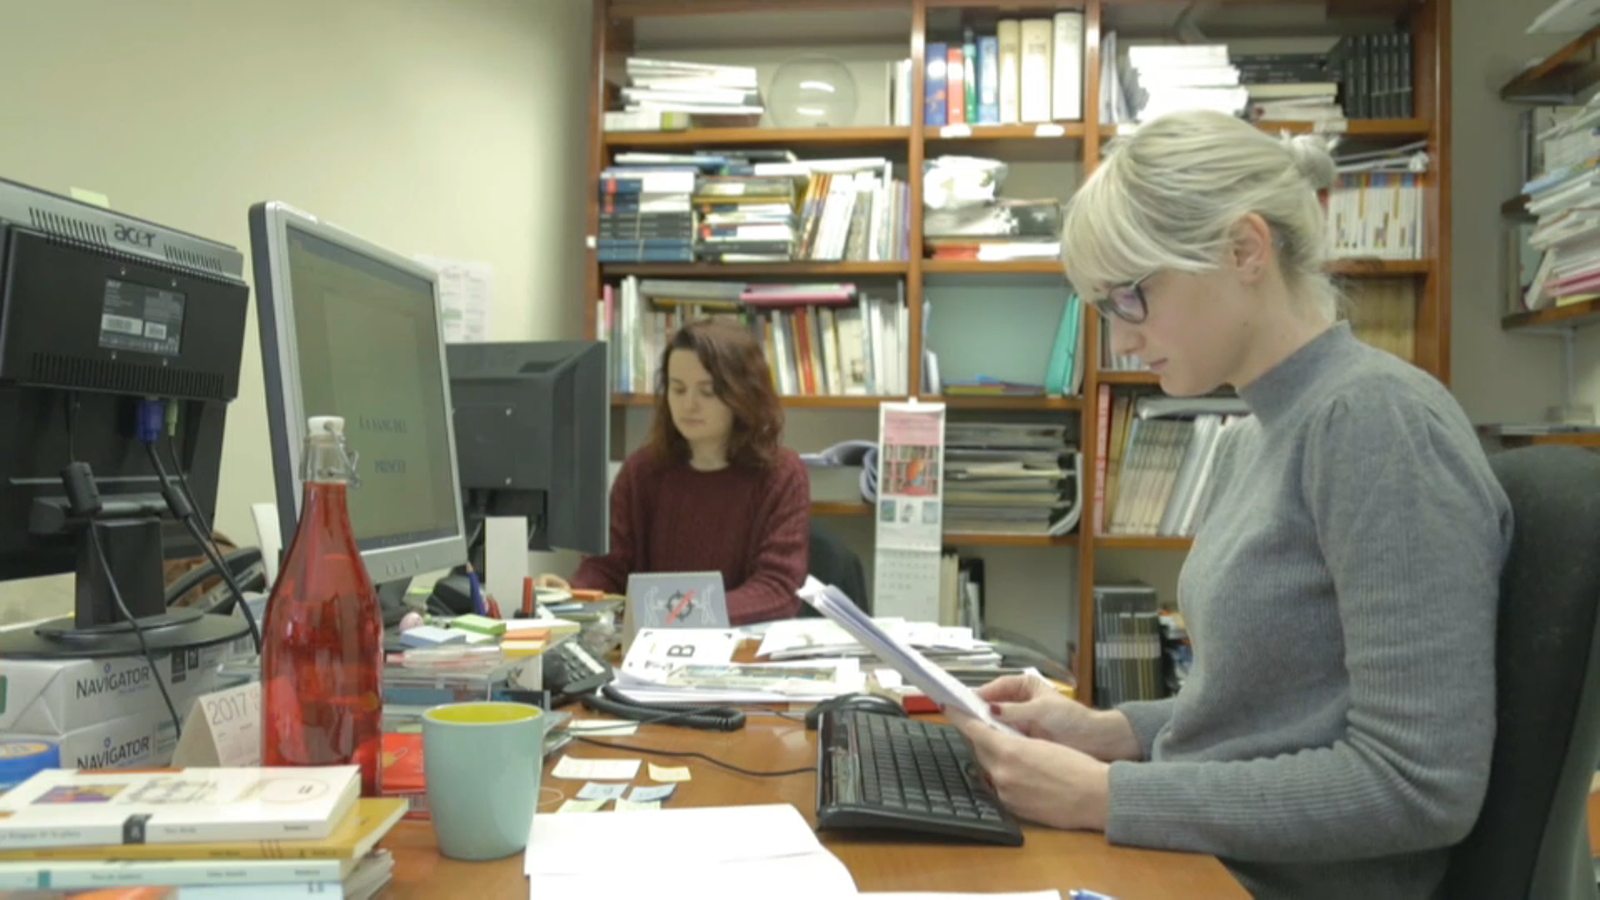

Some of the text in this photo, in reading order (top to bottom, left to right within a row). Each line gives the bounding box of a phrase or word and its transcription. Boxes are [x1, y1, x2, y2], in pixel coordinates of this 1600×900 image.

[114, 222, 156, 248] acer
[666, 644, 696, 657] B
[76, 664, 150, 700] NAVIGATOR
[207, 692, 248, 725] 2017
[77, 737, 150, 769] NAVIGATOR
